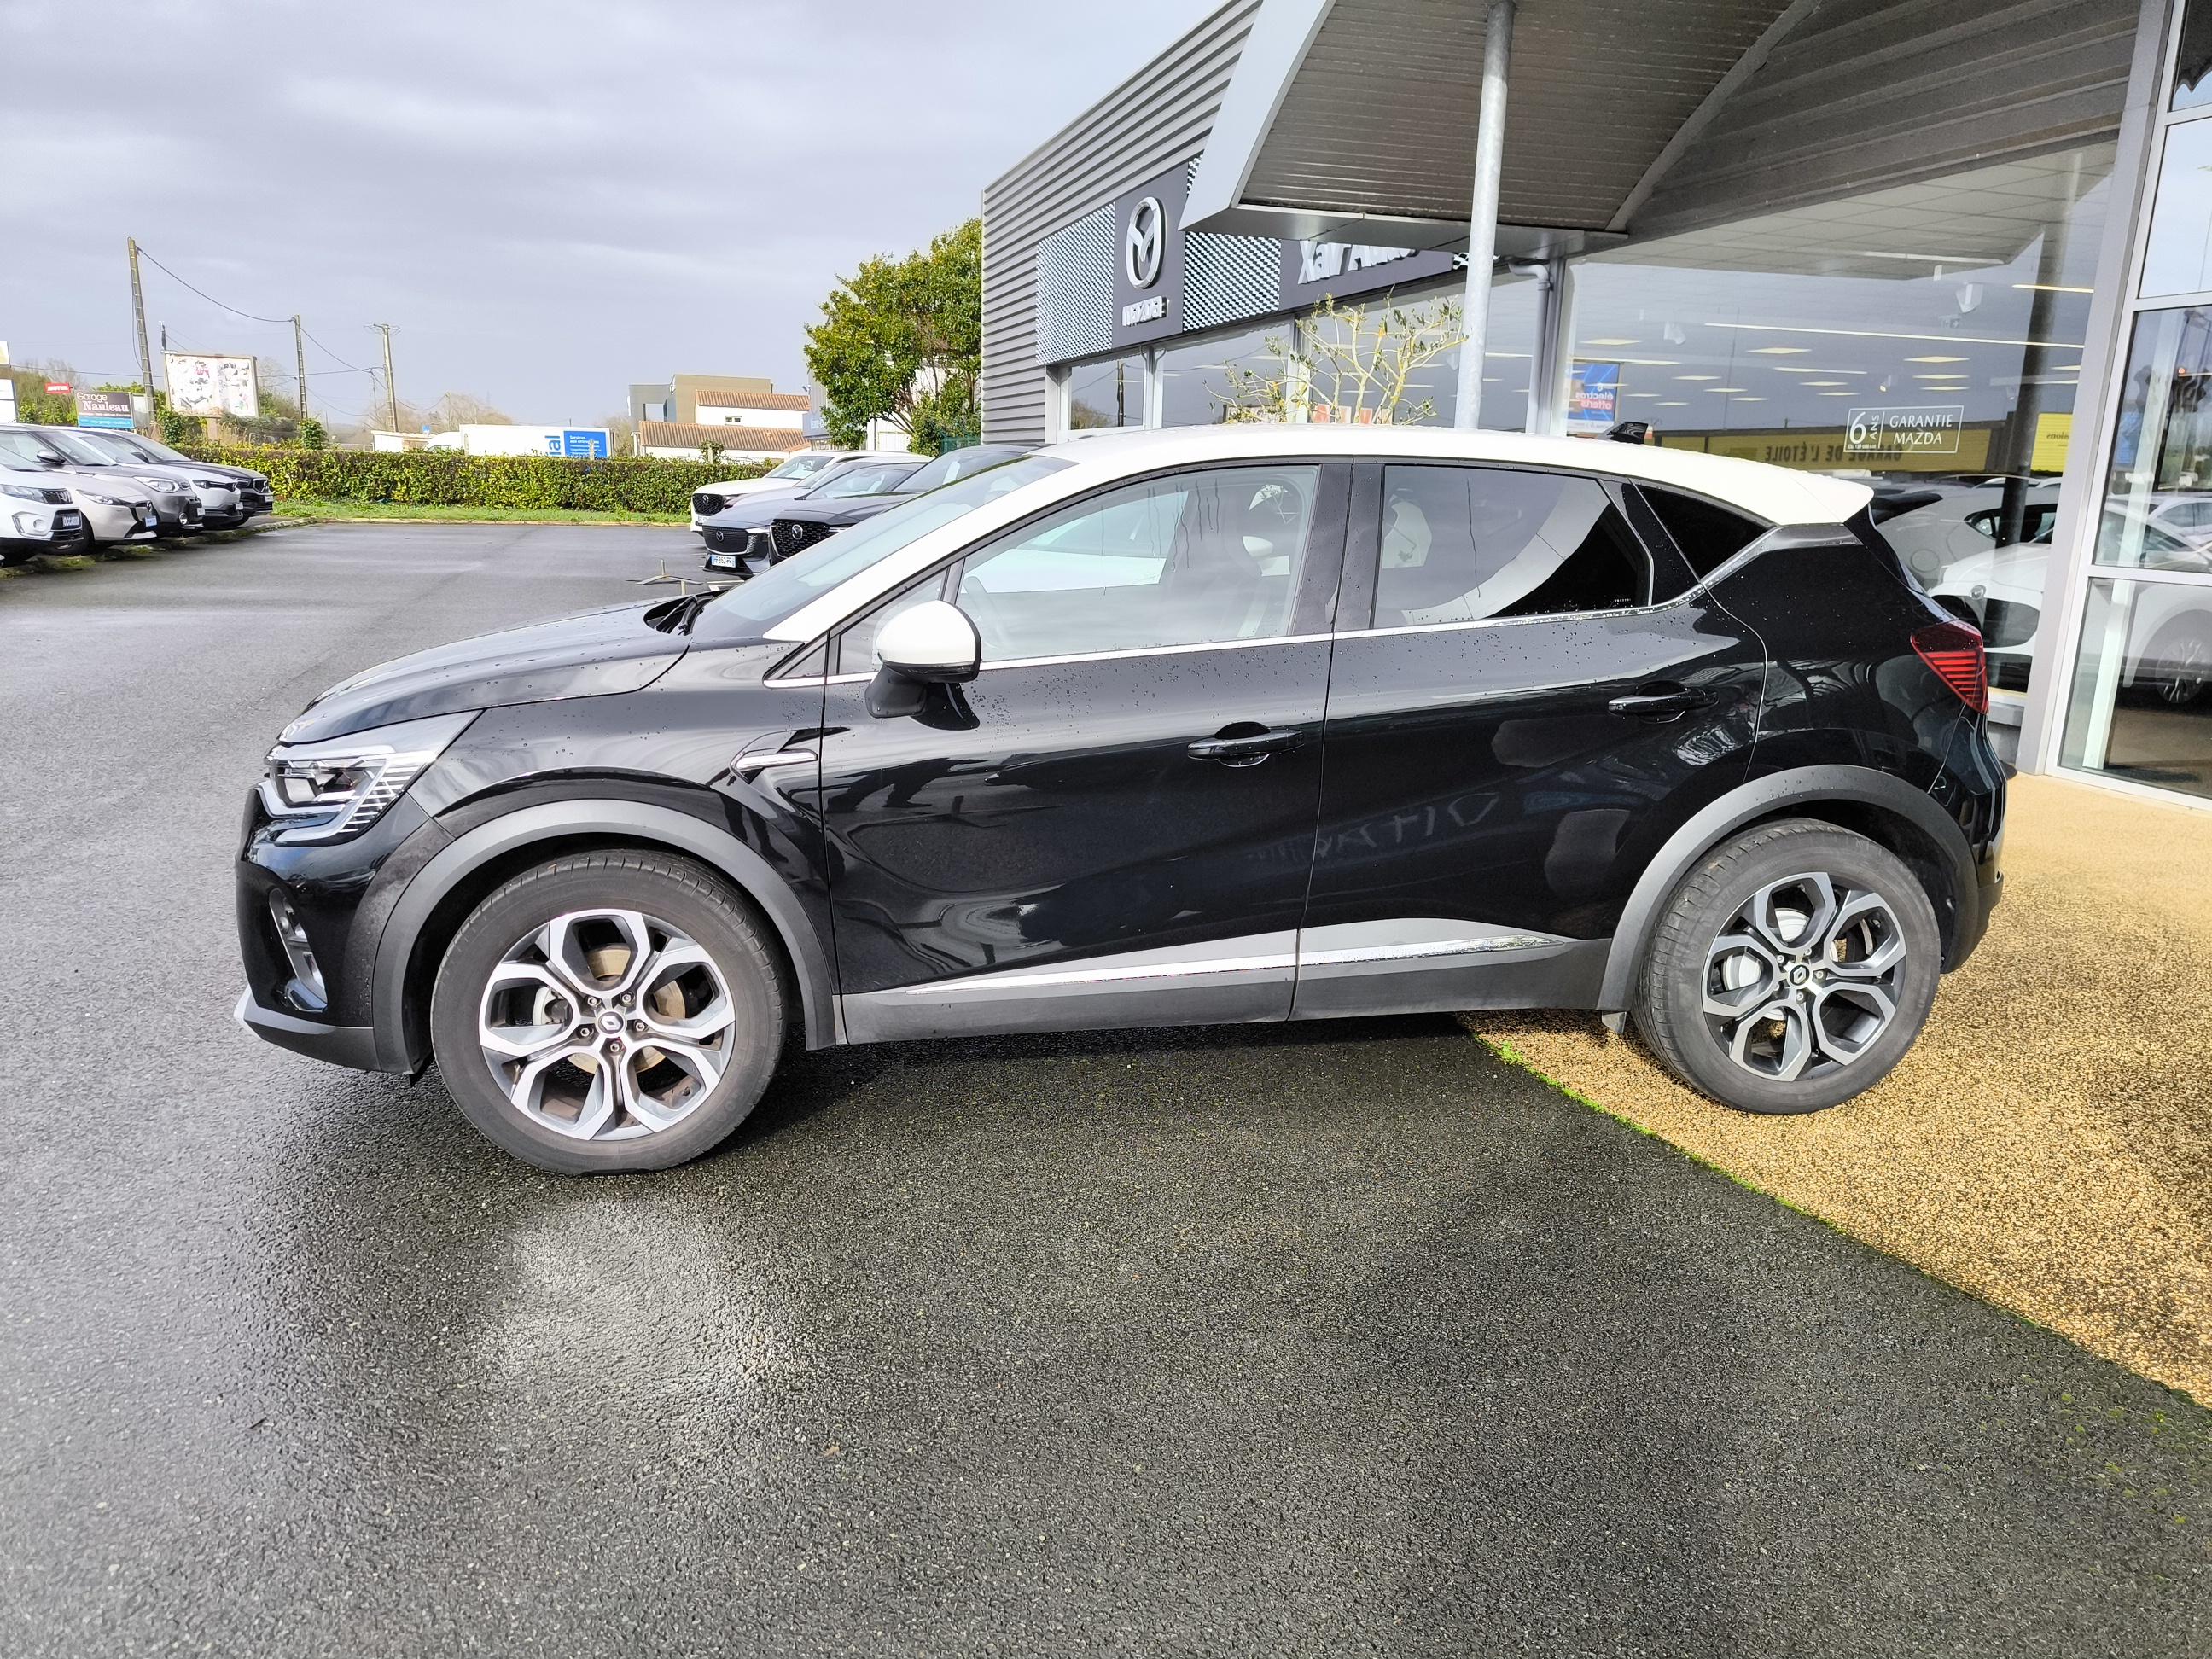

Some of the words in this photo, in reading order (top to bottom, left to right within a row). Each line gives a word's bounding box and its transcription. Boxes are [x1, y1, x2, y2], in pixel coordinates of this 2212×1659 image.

[76, 392, 108, 403] Garage
[83, 401, 129, 412] Nauleau
[1869, 415, 1880, 440] ANS
[1889, 414, 1953, 428] GARANTIE
[1849, 411, 1866, 445] 6
[1893, 432, 1943, 445] MAZDA
